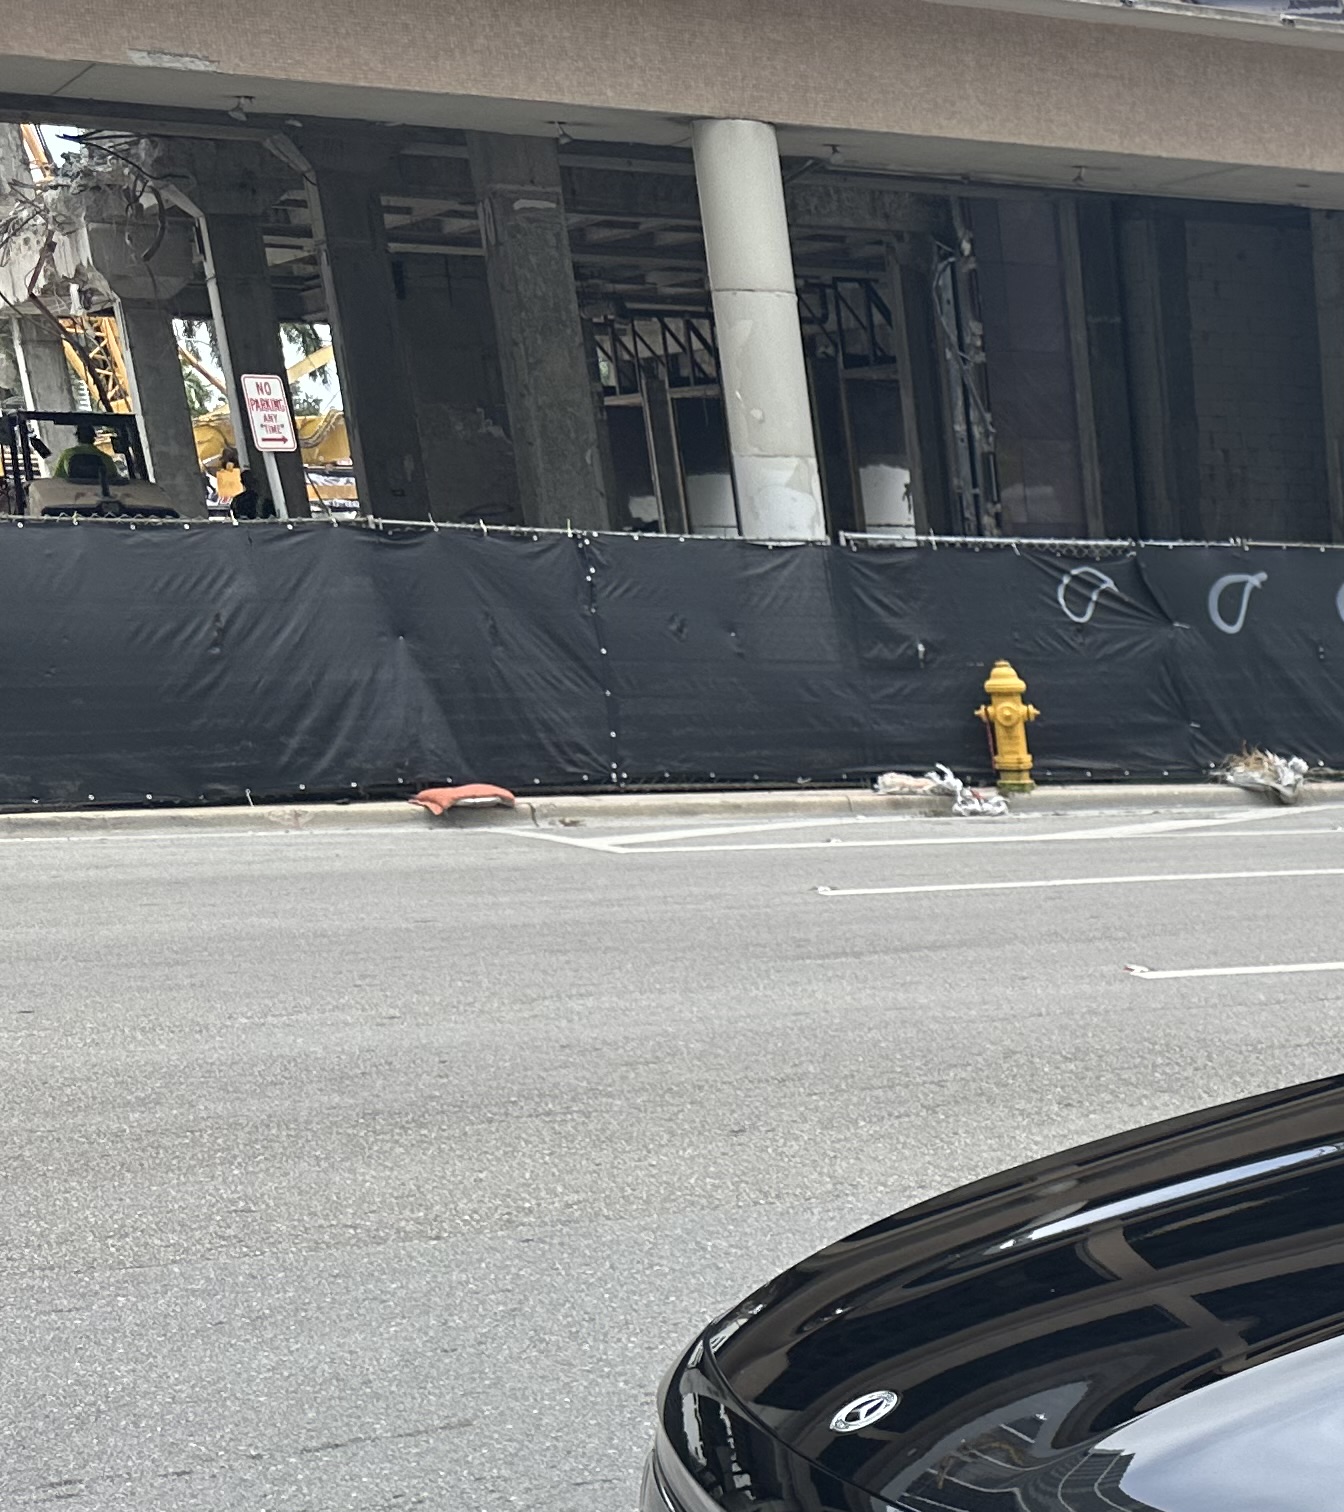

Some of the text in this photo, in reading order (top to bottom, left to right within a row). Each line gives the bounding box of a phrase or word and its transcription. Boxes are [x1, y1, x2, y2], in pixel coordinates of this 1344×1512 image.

[255, 381, 272, 396] NO
[249, 398, 286, 413] PARKING
[263, 413, 278, 424] ANY
